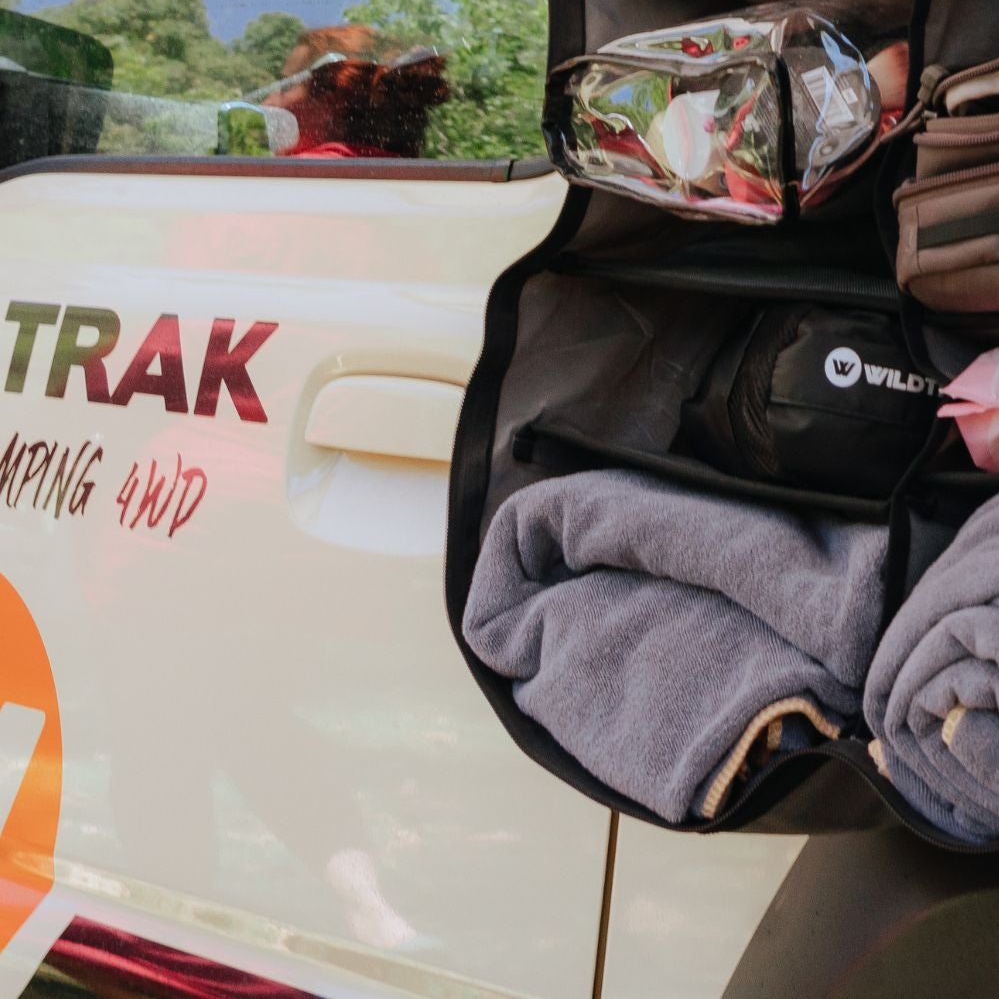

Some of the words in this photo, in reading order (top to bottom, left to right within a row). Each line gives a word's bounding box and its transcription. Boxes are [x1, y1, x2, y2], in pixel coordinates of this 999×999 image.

[4, 300, 279, 423] TRAK
[864, 362, 948, 398] WILDT
[116, 452, 208, 538] 4WD
